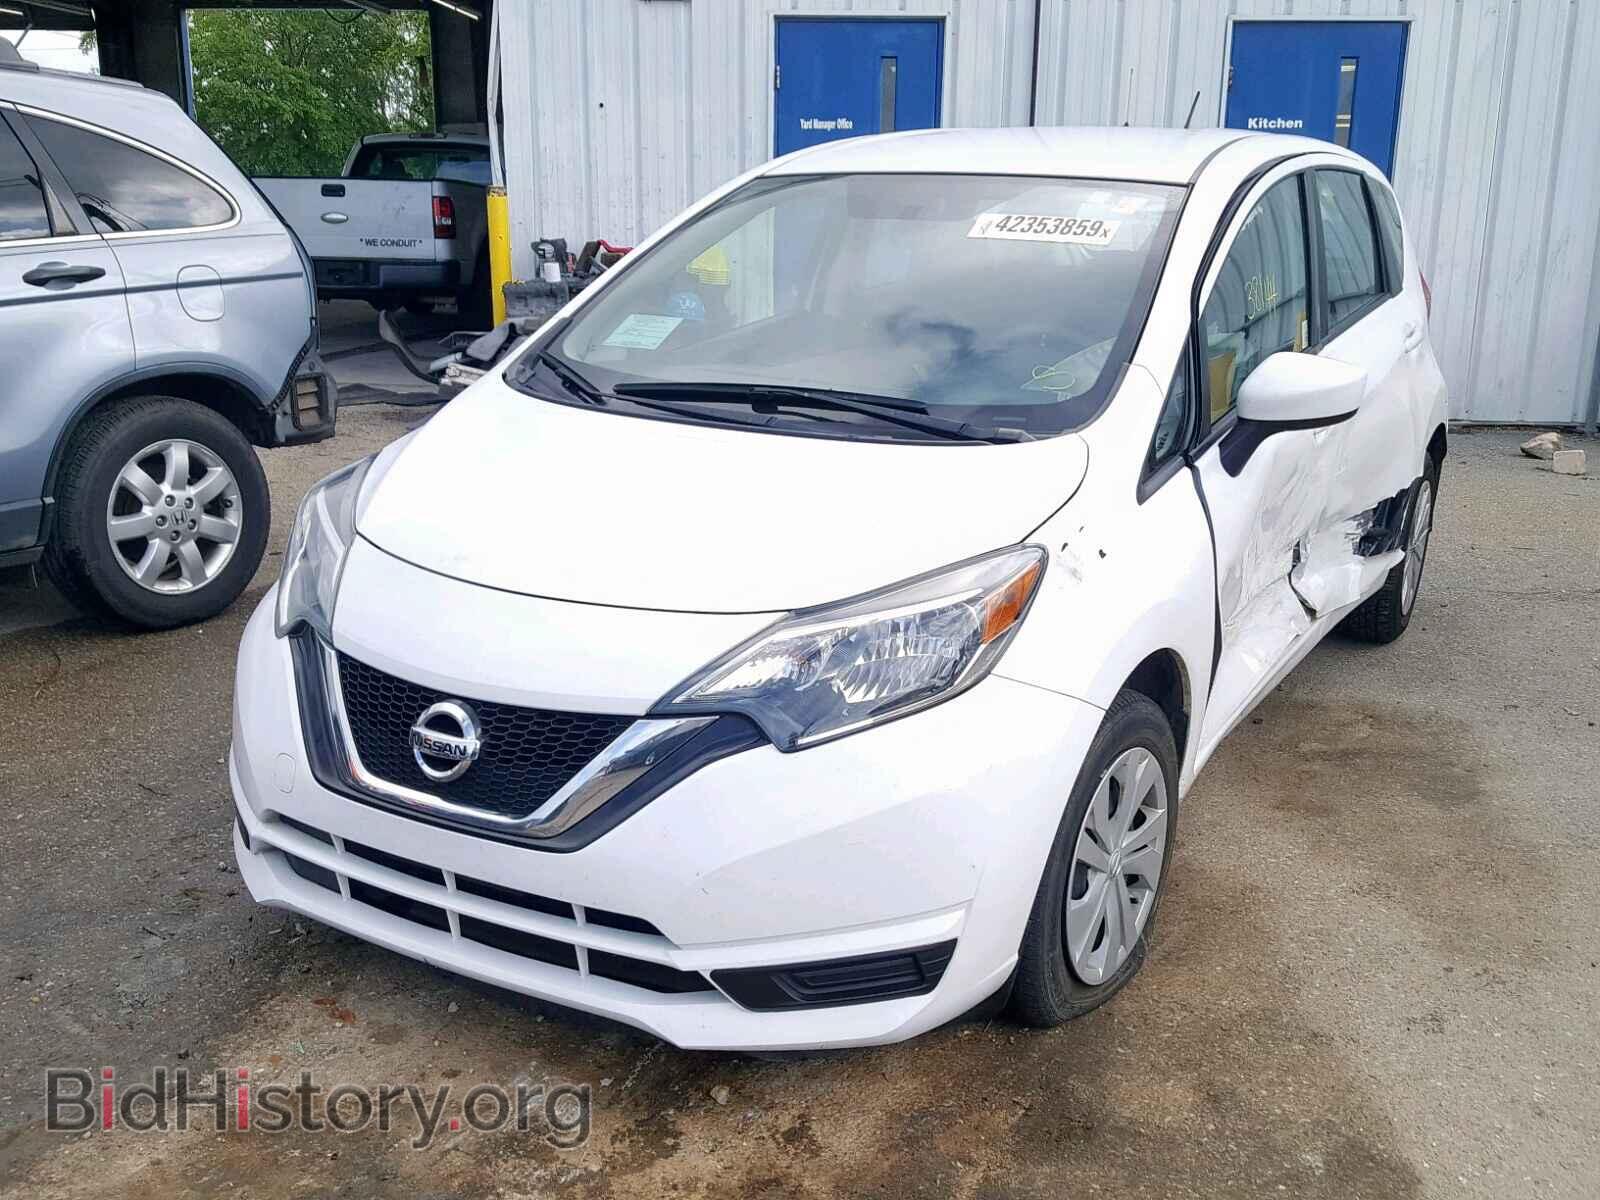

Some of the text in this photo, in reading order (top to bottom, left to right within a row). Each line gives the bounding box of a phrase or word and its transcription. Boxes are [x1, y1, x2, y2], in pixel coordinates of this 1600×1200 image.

[800, 118, 812, 129] Yard
[837, 118, 853, 129] Office
[1248, 117, 1302, 129] Kitchen
[995, 215, 1103, 237] 42353859
